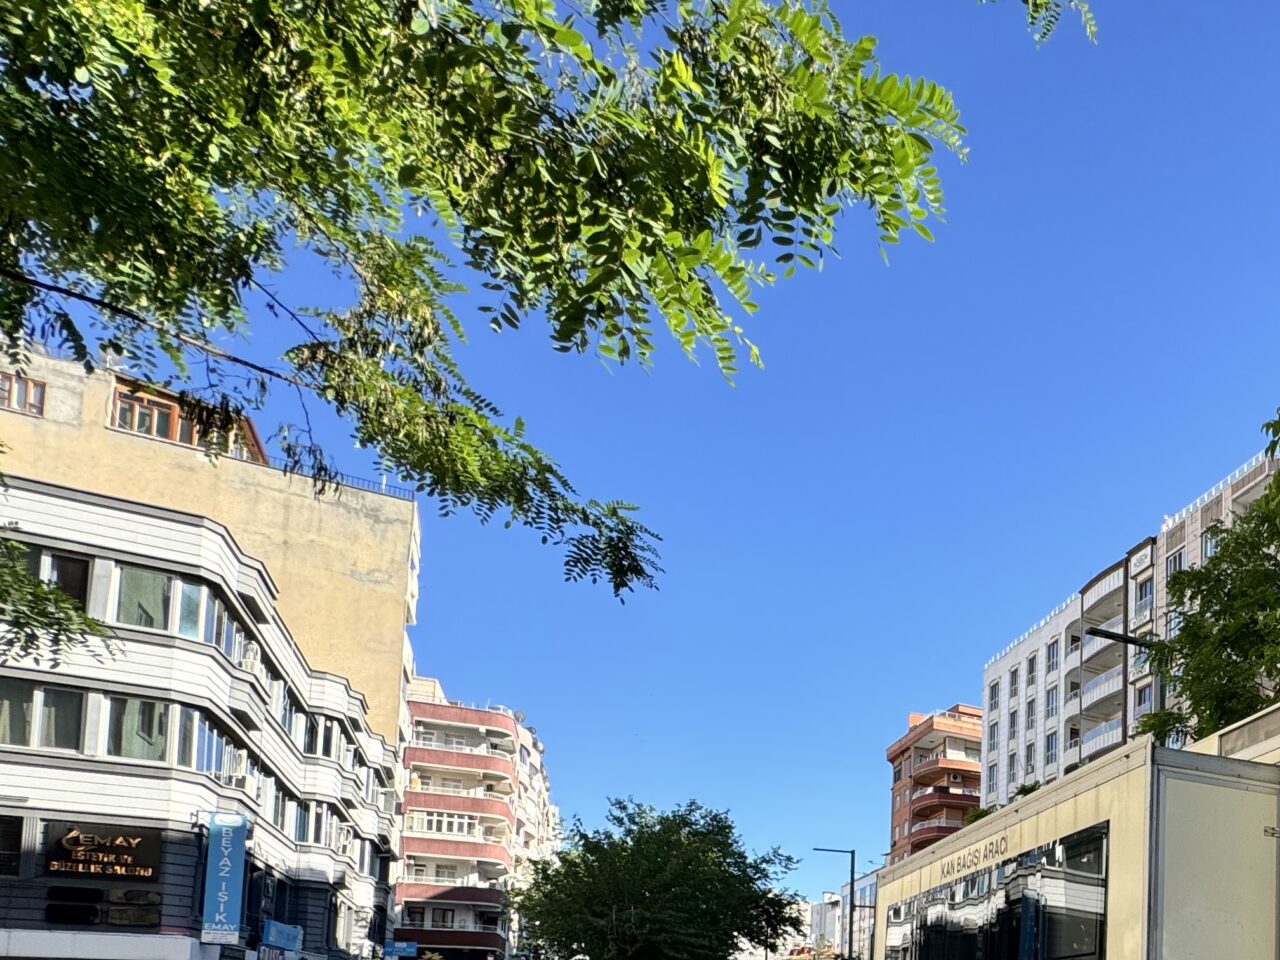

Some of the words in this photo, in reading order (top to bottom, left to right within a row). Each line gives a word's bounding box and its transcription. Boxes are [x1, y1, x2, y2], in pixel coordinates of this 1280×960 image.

[218, 827, 234, 877] BEYAZ
[941, 857, 956, 878] KAN
[956, 847, 982, 872] BAĞIŞI
[982, 835, 1009, 863] ARACI
[49, 860, 103, 874] GÜZELLİK
[204, 922, 237, 931] EMAY
